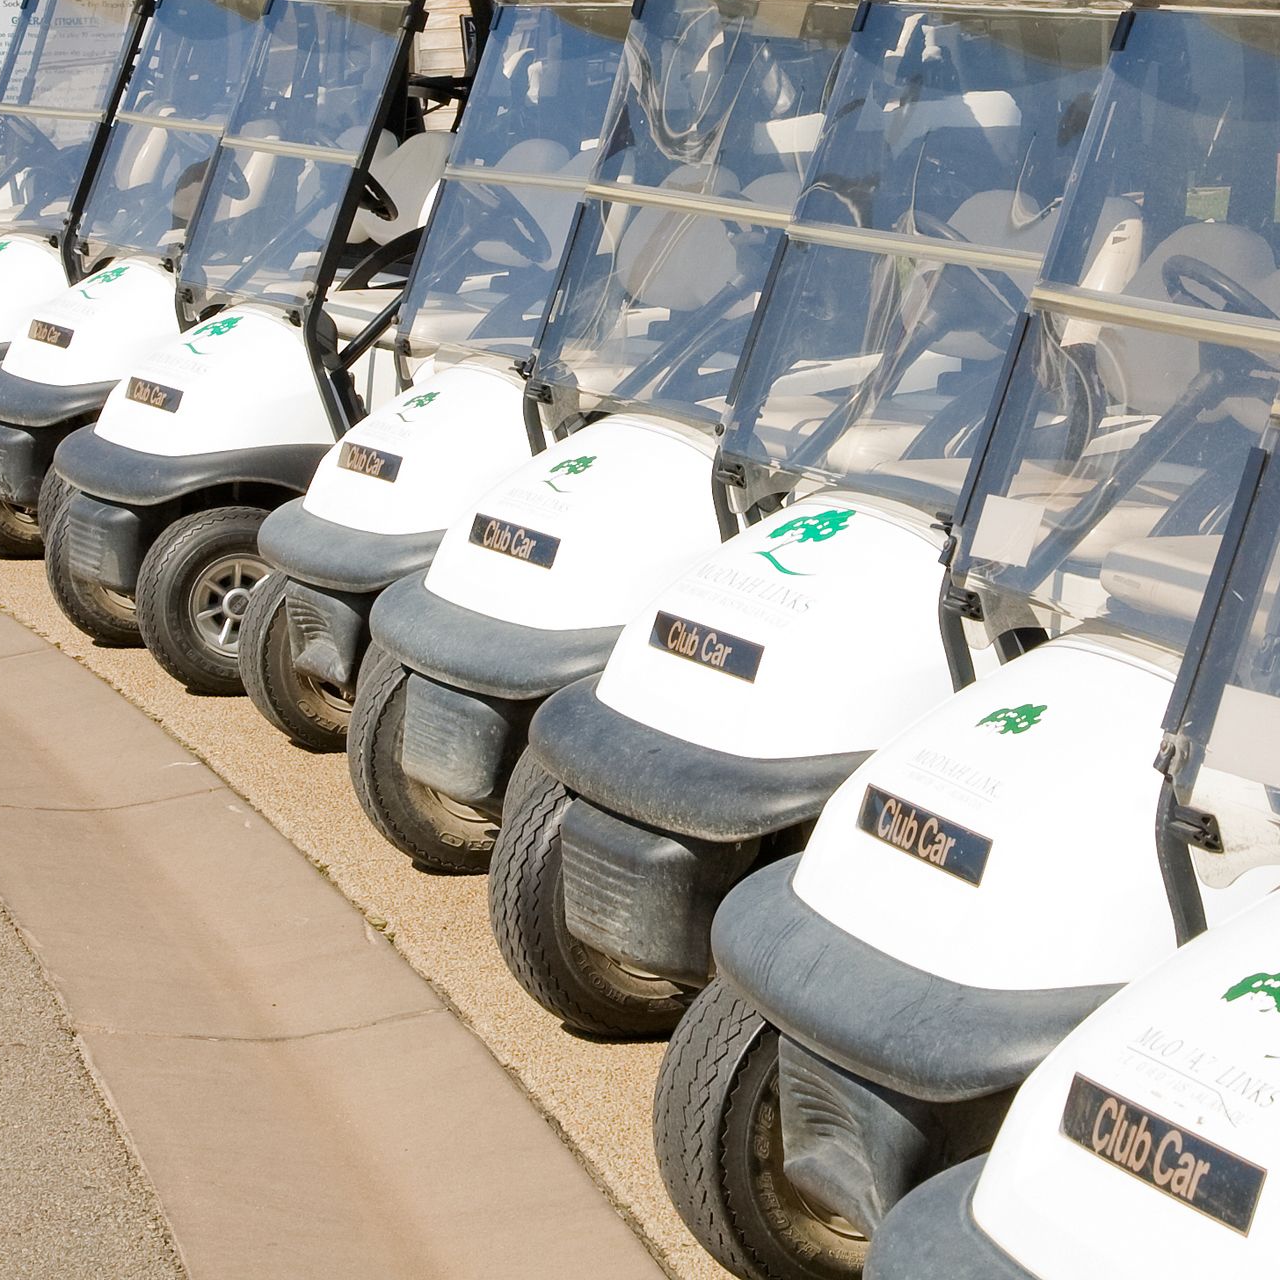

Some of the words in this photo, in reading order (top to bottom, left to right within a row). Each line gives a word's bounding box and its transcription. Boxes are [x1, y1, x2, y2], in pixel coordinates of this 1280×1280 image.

[133, 381, 151, 402] Club
[150, 386, 168, 406] Car
[347, 446, 367, 470] Club
[366, 452, 385, 476] Car
[483, 520, 511, 552] Club
[511, 529, 536, 559] Car
[667, 620, 700, 657] Club
[701, 632, 732, 667] Car
[876, 798, 918, 850] Club
[916, 817, 956, 866] Car
[1091, 1097, 1153, 1173] Club
[1152, 1130, 1210, 1200] Car
